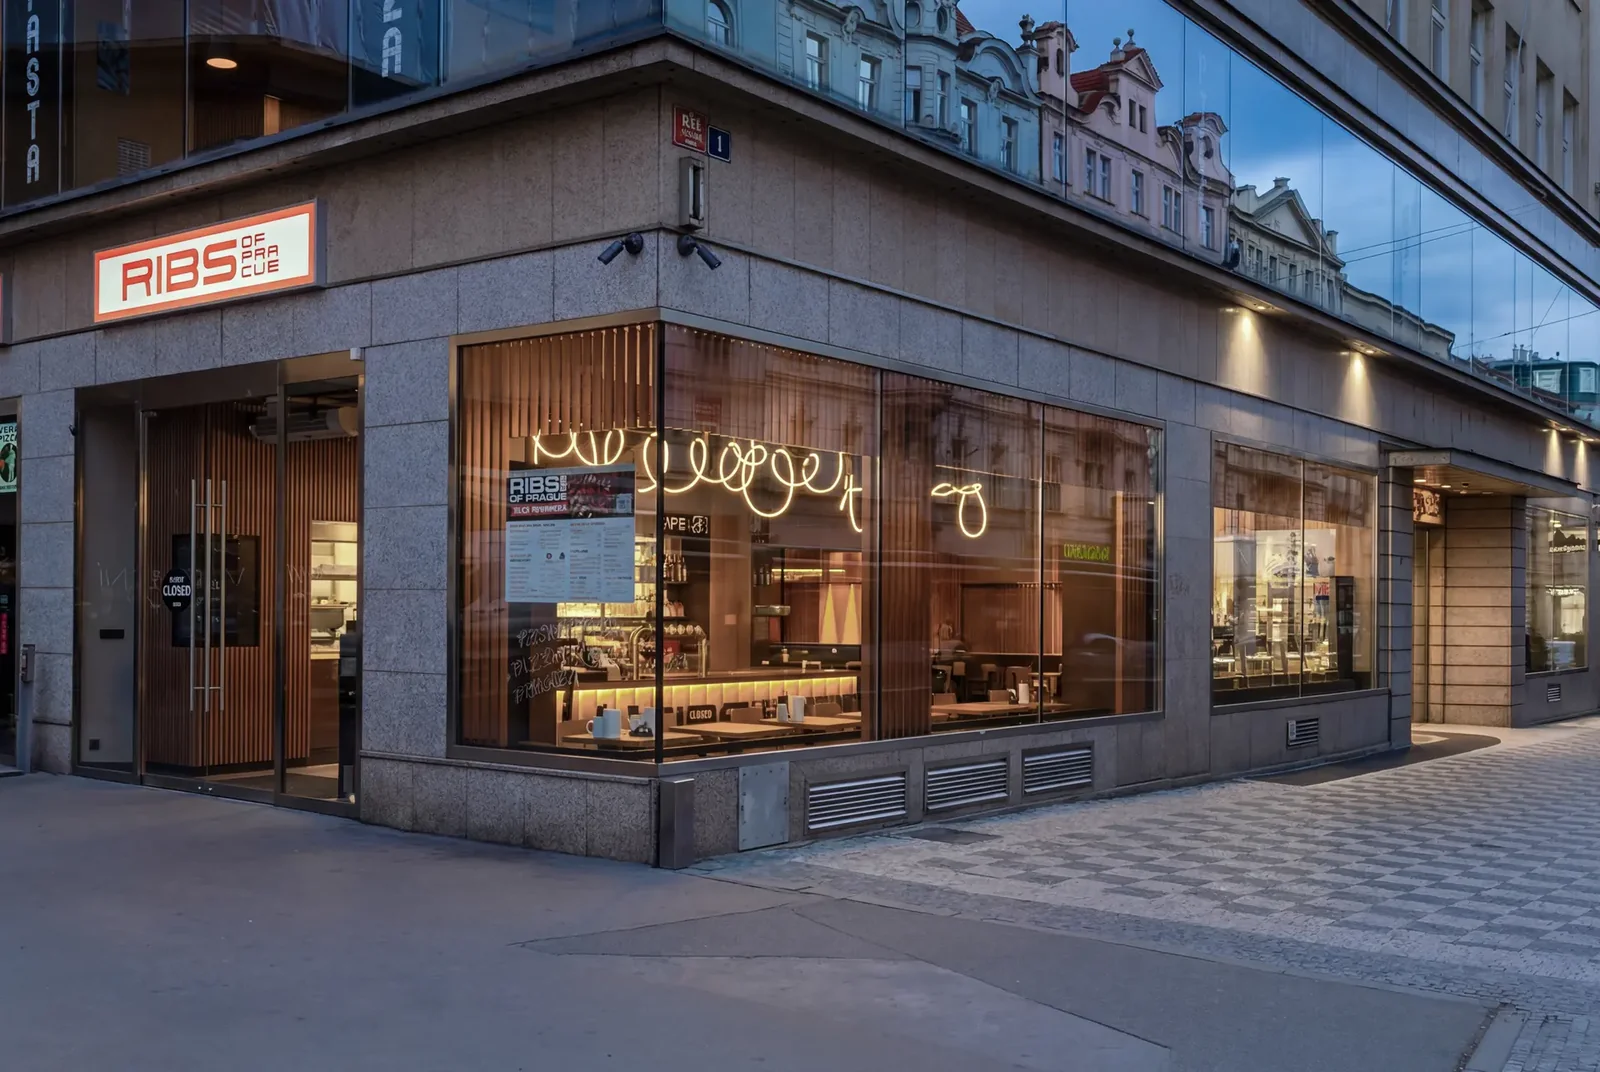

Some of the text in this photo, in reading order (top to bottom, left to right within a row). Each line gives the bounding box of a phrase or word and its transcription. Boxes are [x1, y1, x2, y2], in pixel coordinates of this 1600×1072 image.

[242, 233, 265, 248] OF
[242, 245, 278, 263] PRA
[122, 239, 237, 301] RIBS
[510, 475, 560, 495] RIBS
[510, 492, 567, 503] OF PRAGUE
[664, 516, 686, 530] APE
[162, 584, 191, 597] CLOSED
[689, 709, 713, 720] CLOSED
